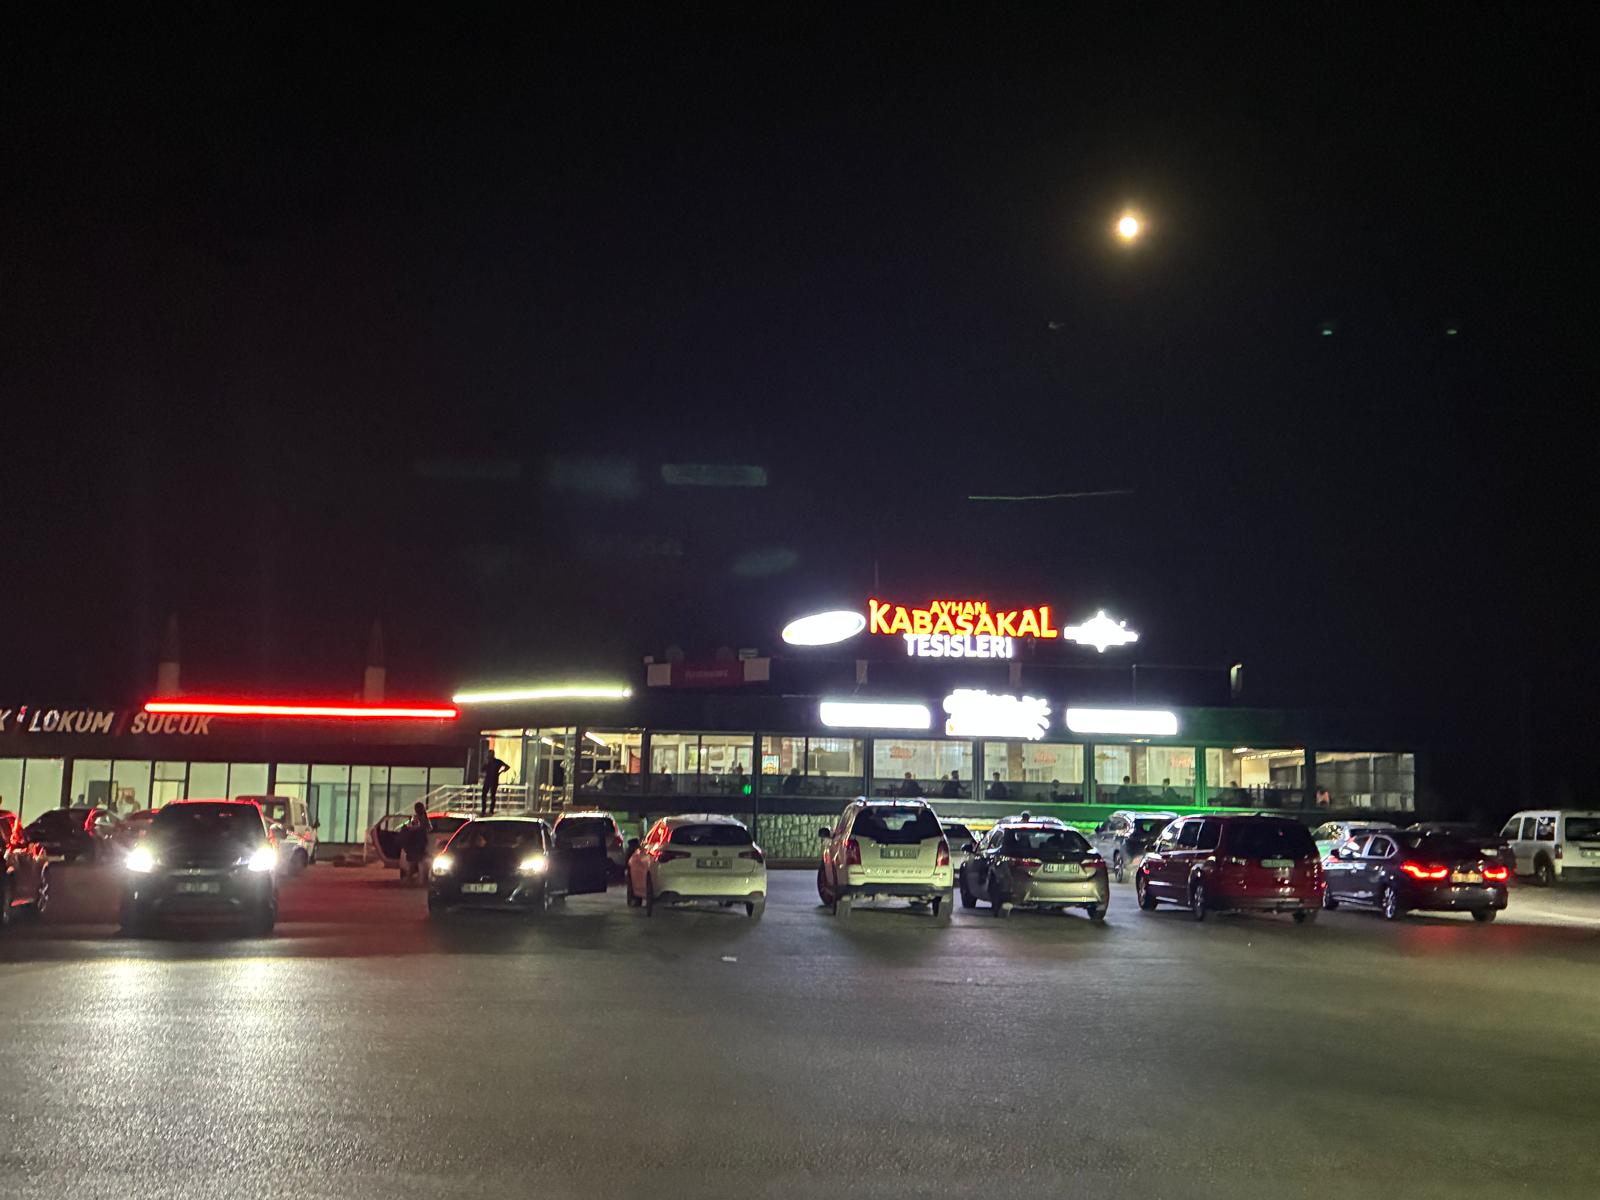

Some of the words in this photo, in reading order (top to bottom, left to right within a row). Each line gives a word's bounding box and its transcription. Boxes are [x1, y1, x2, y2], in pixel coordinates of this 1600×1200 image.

[869, 599, 1058, 638] KABASAKAL
[930, 600, 987, 616] AYHAN
[28, 709, 115, 734] LOKUM
[130, 711, 212, 735] SUCUK
